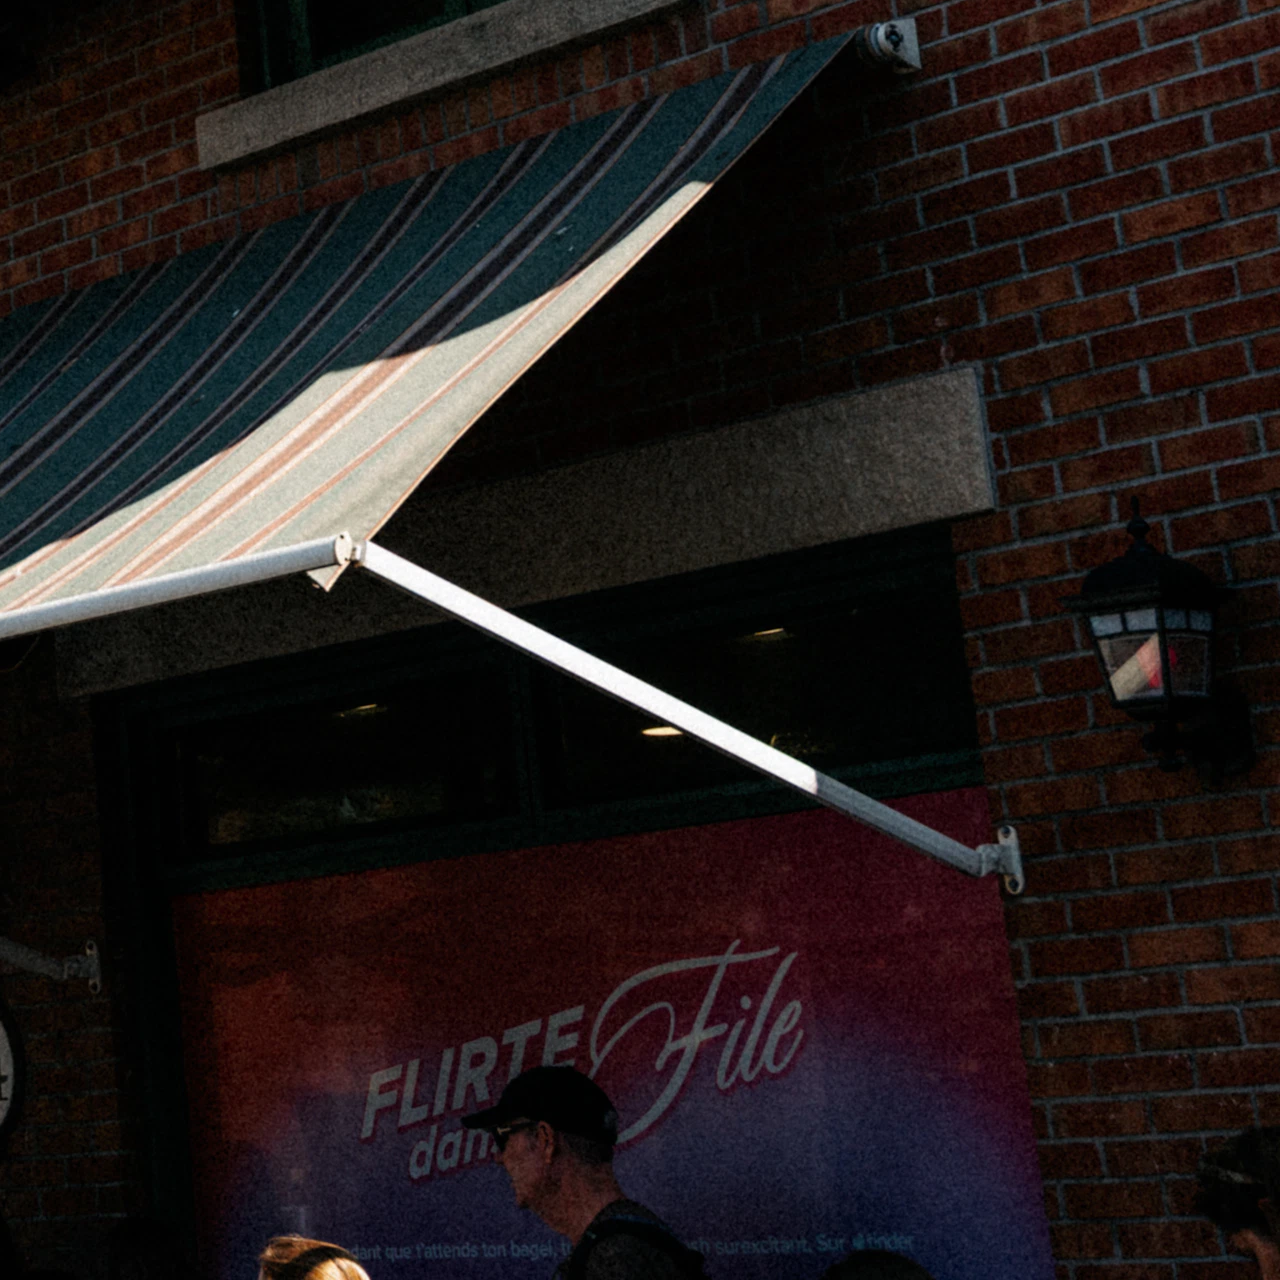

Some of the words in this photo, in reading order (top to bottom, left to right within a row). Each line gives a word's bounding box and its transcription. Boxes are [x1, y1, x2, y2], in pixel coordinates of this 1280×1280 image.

[360, 1004, 586, 1140] FLIRTE
[588, 939, 805, 1146] File
[409, 1125, 500, 1179] dan
[347, 1243, 382, 1261] dant
